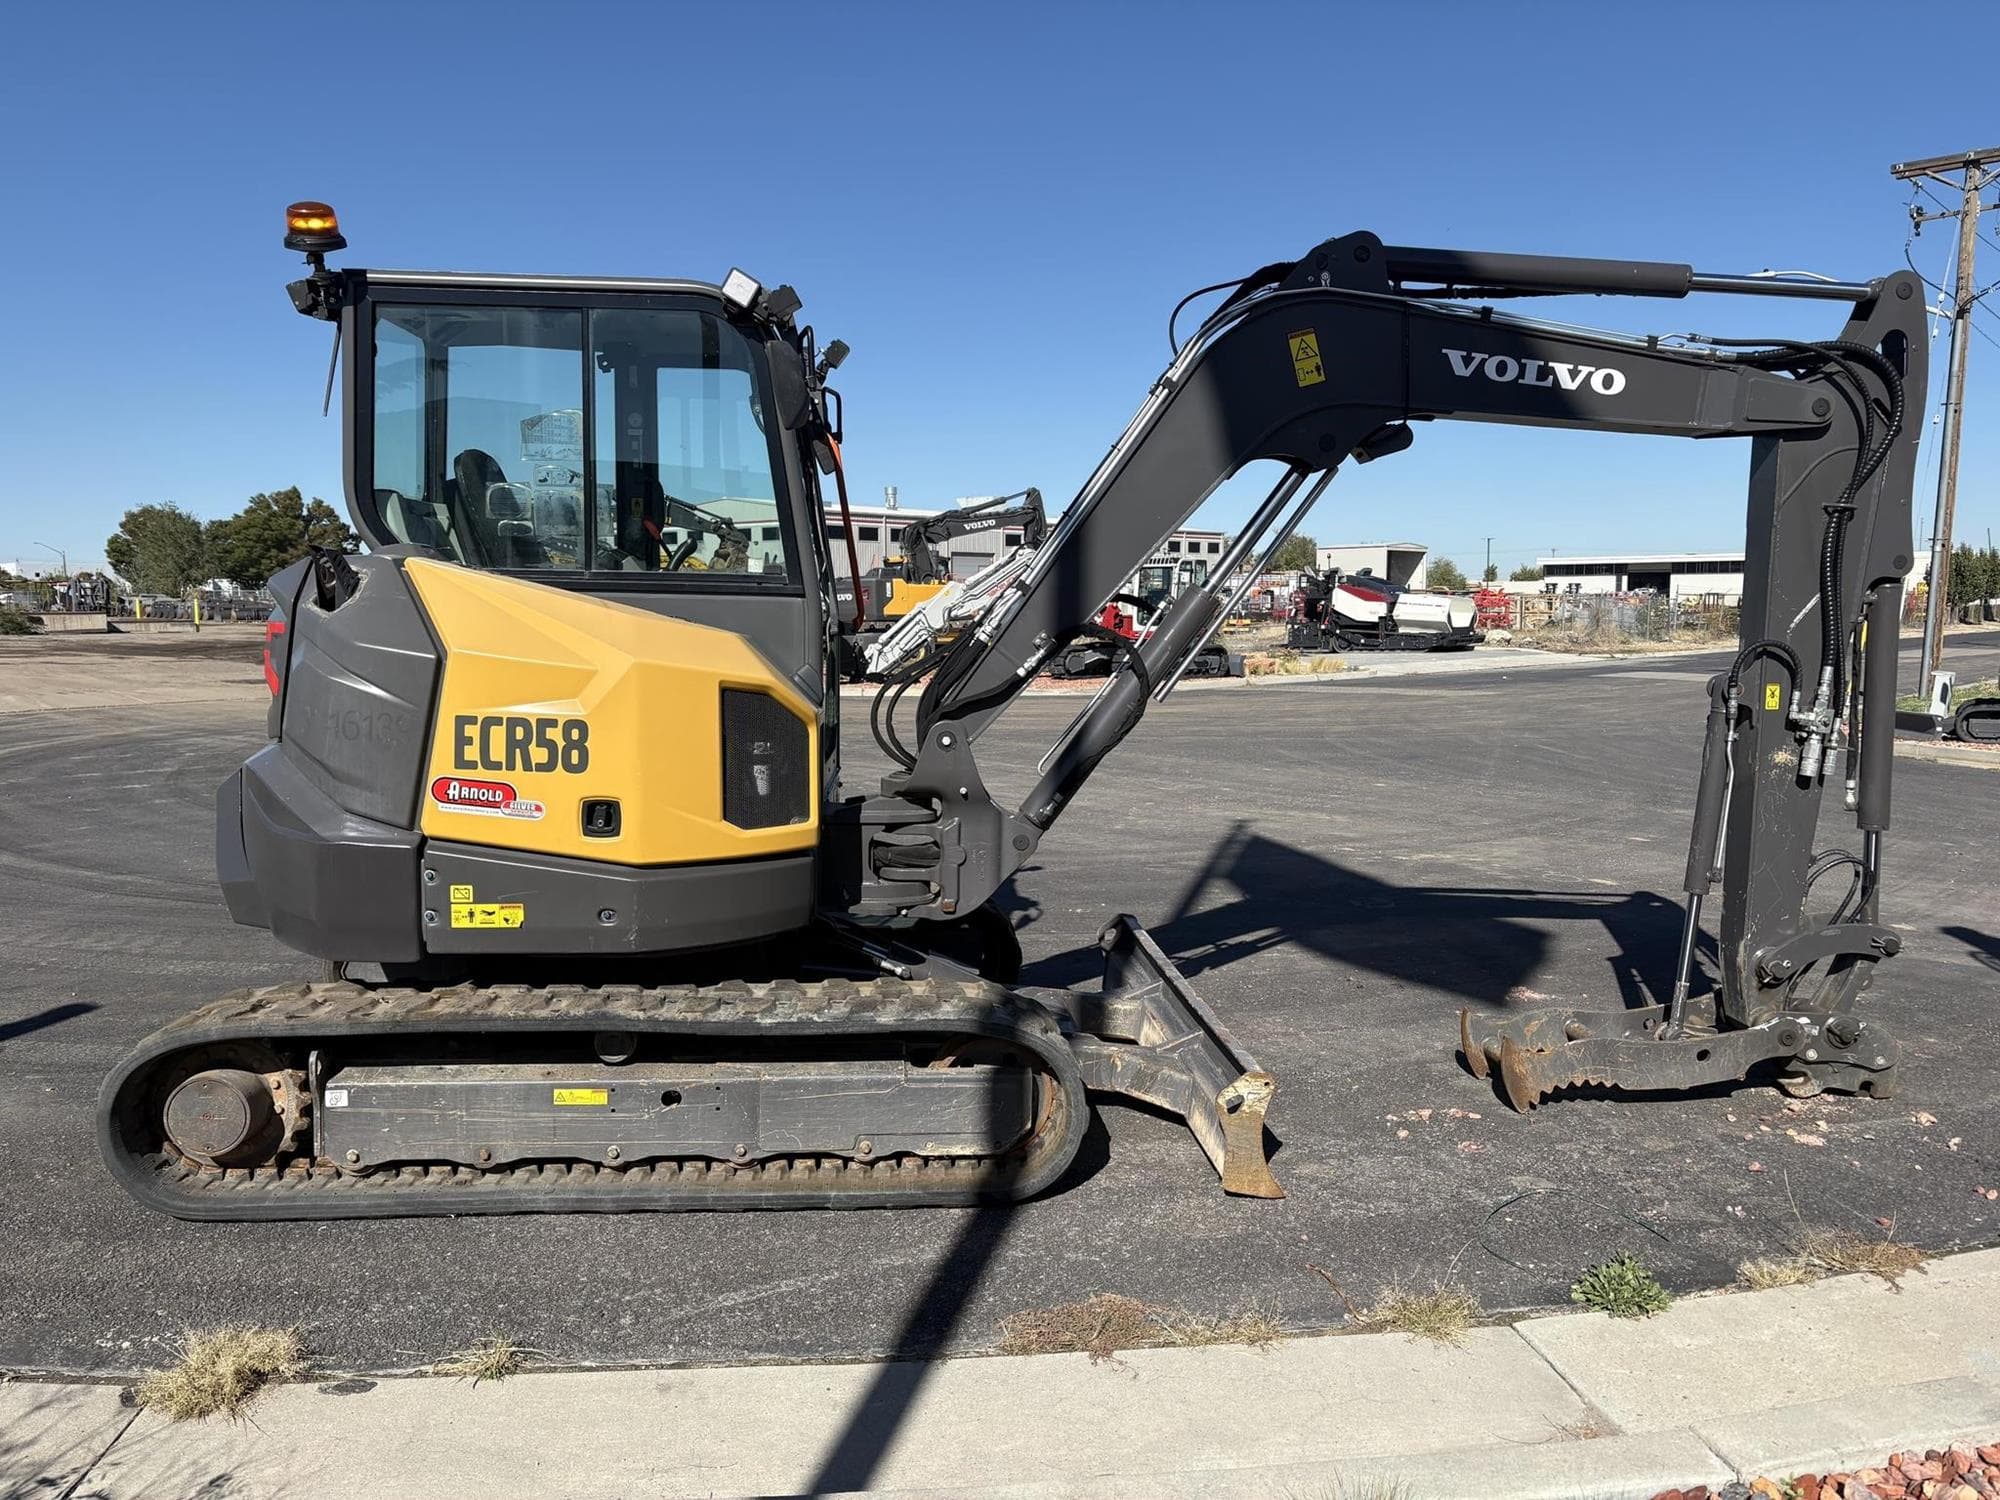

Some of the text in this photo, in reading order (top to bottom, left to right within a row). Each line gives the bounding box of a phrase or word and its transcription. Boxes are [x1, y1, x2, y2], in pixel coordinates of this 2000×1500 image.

[1441, 348, 1627, 396] VOLVO
[963, 519, 996, 531] VOLVO
[454, 714, 589, 774] ECR58
[447, 781, 503, 802] ARNOLD
